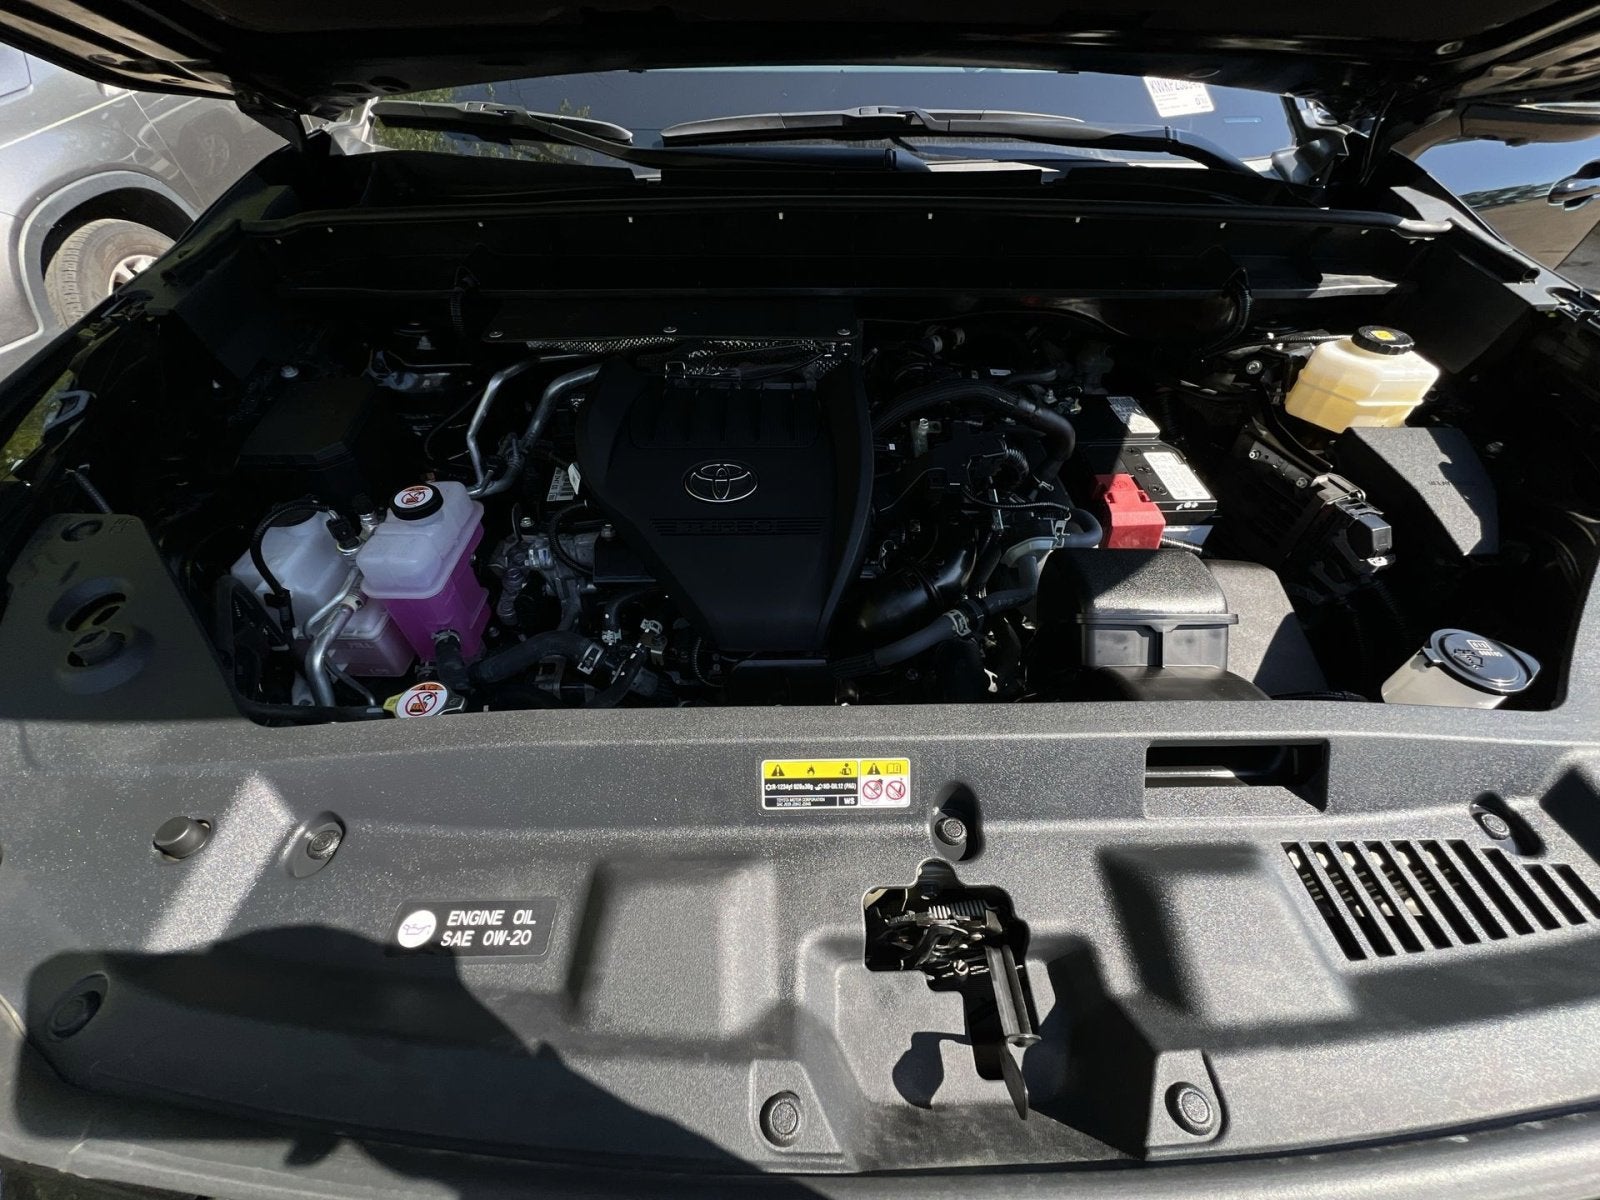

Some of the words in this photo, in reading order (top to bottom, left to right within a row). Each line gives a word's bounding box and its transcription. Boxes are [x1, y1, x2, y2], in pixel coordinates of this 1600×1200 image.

[446, 910, 505, 926] ENGINE
[512, 909, 537, 925] OIL
[440, 930, 475, 947] SAE
[482, 929, 532, 946] 0W-20
